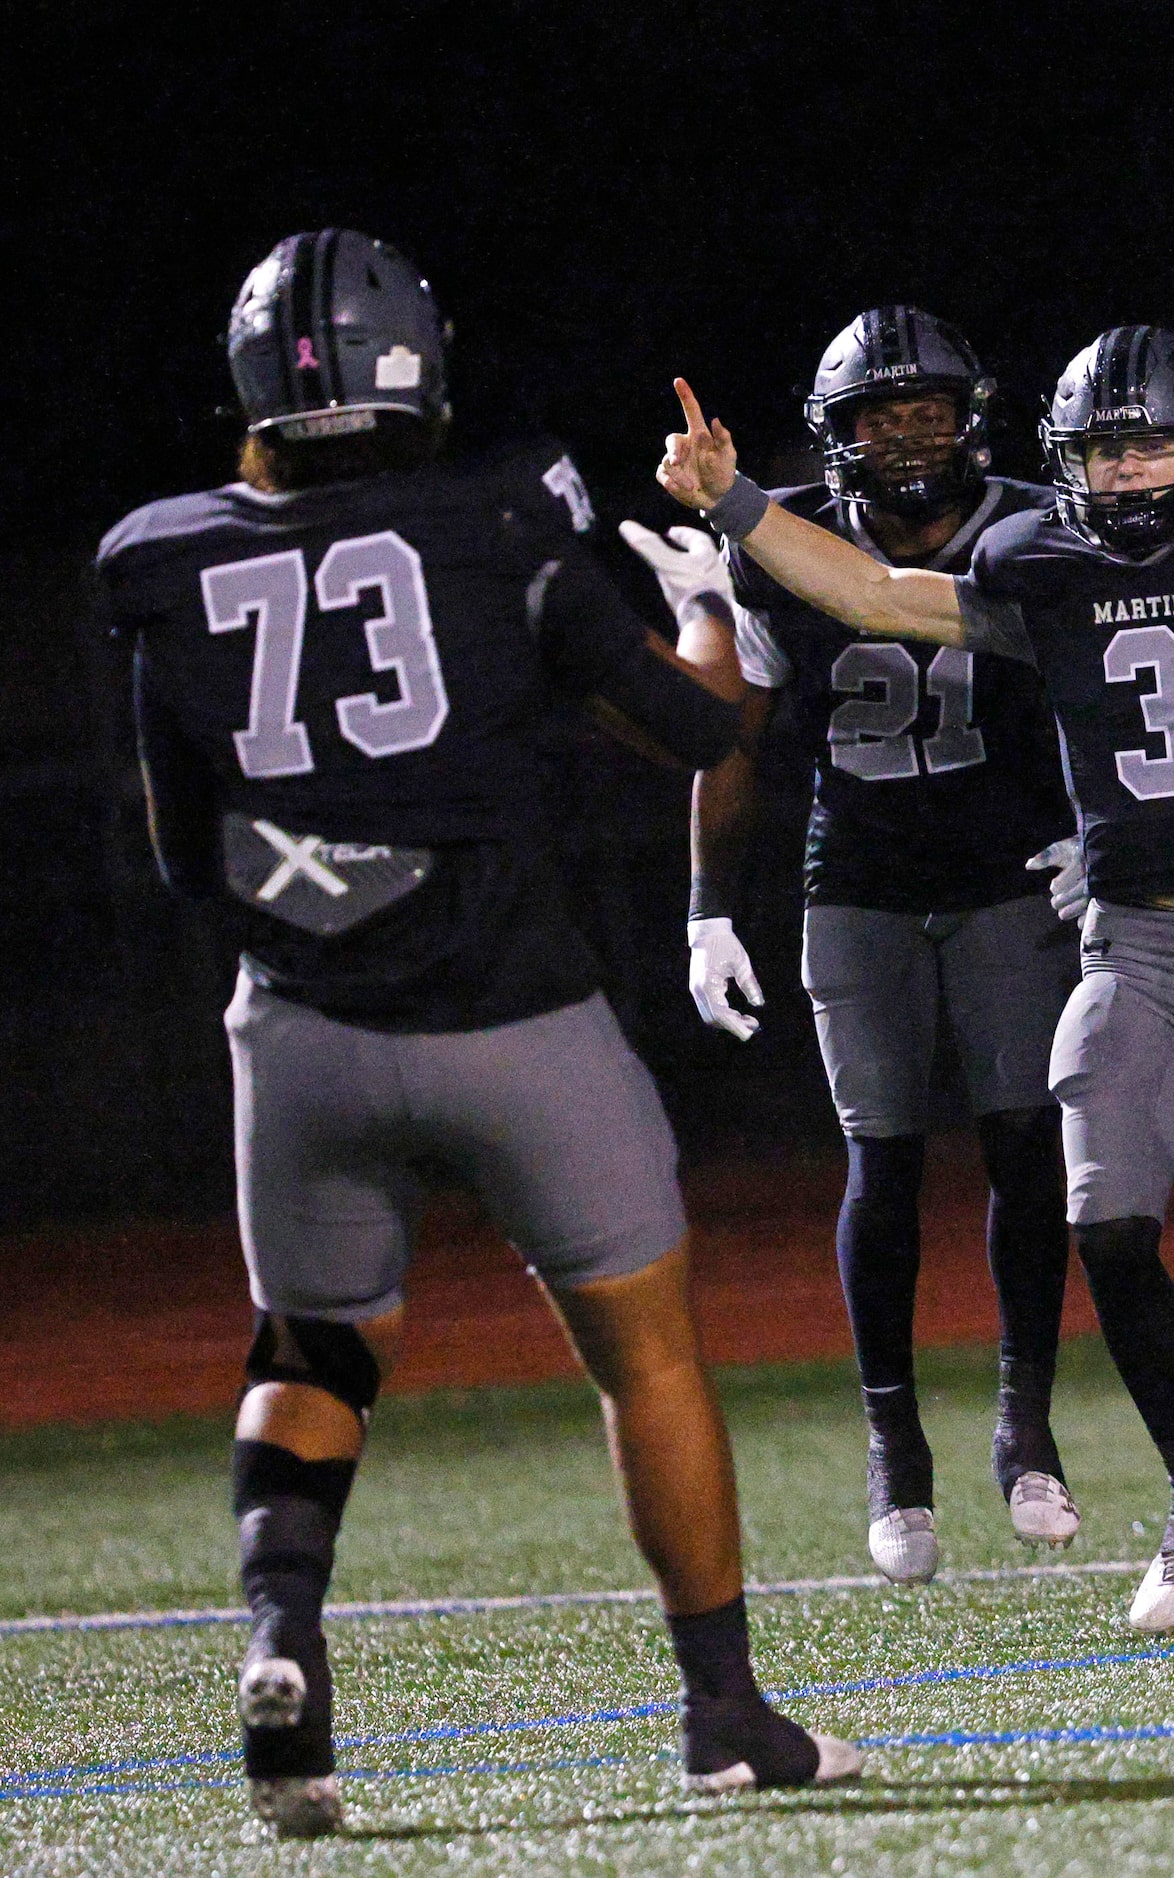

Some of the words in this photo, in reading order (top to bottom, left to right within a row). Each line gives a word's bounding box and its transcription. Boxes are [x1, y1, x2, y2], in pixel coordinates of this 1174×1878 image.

[873, 363, 918, 380] MARTIN
[1095, 408, 1142, 422] MARTIN
[201, 530, 450, 778] 73
[827, 642, 987, 781] 21
